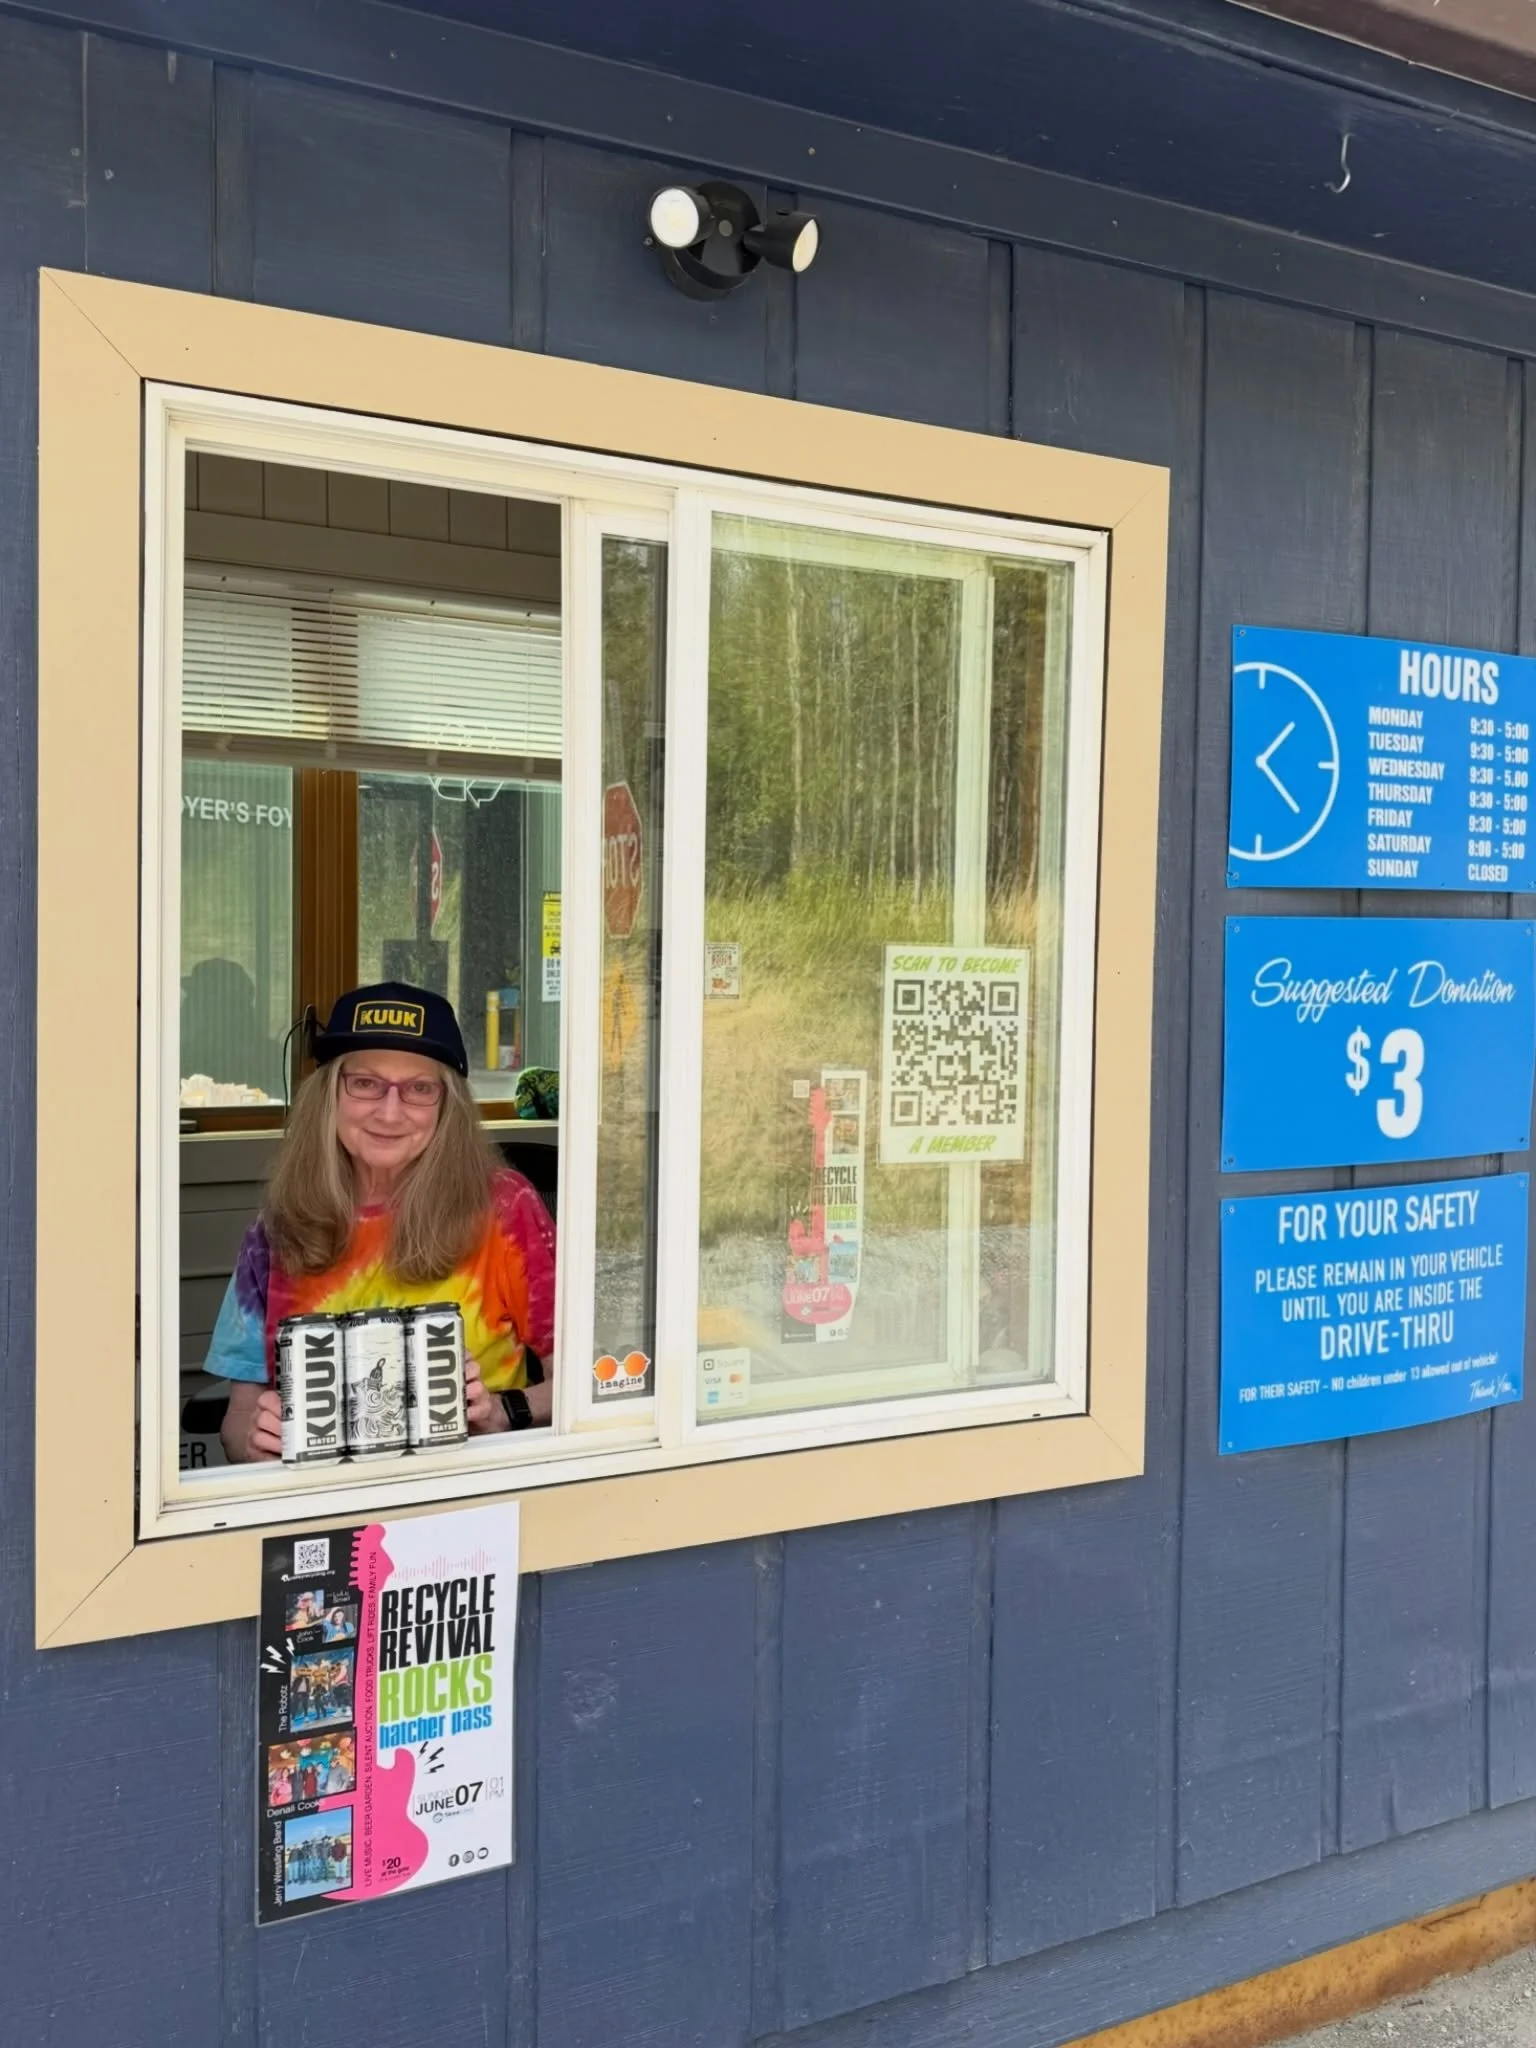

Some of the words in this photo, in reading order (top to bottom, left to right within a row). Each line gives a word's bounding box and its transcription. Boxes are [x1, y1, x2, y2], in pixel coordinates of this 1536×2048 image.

[1399, 649, 1499, 705] HOURS
[1368, 706, 1424, 729] MONDAY
[1504, 721, 1529, 740] 5:00
[1368, 731, 1424, 753] TUESDAY
[1504, 746, 1529, 764] 5:00
[1368, 757, 1445, 781] WEDNESDAY
[181, 795, 250, 823] YER'S
[1367, 782, 1433, 805] THURSDAY
[1504, 793, 1528, 812] 5:00
[1367, 808, 1413, 828] FRIDAY
[1502, 817, 1526, 836] 5:00
[1367, 833, 1432, 854] SATURDAY
[1501, 842, 1525, 860] 5:00
[1367, 858, 1419, 878] SUNDAY
[1468, 863, 1508, 882] CLOSED
[892, 955, 932, 972] SCAN
[937, 957, 958, 972] TO
[962, 958, 1022, 974] BECOME
[1251, 957, 1399, 1023] Suggested
[1408, 960, 1516, 1008] Donation
[360, 1009, 417, 1028] KUUK
[1345, 1025, 1425, 1139] $3
[910, 1135, 924, 1154] A
[926, 1135, 997, 1154] MEMBER
[1279, 1203, 1328, 1244] FOR
[1335, 1197, 1399, 1239] YOUR
[1405, 1190, 1480, 1233] SAFETY
[1255, 1265, 1317, 1294] PLEASE
[1324, 1259, 1386, 1287] REMAIN
[1390, 1256, 1405, 1280] IN
[1411, 1252, 1448, 1277] YOUR
[1450, 1244, 1503, 1273] VEHICLE
[812, 1287, 830, 1302] 07
[1282, 1295, 1330, 1322] UNTIL
[1336, 1292, 1368, 1316] YOU
[1374, 1288, 1403, 1313] ARE
[1408, 1281, 1455, 1309] INSIDE
[1460, 1276, 1483, 1301] THE
[1320, 1310, 1454, 1361] DRIVE-THRU
[305, 1331, 336, 1437] KUUK
[426, 1321, 458, 1425] KUUK
[600, 1377, 643, 1389] imagine
[1239, 1386, 1257, 1404] FOR
[1259, 1384, 1285, 1400] THEIR
[1287, 1379, 1321, 1396] SAFETY
[1331, 1376, 1344, 1392] NO
[1346, 1373, 1382, 1389] children
[1383, 1369, 1407, 1385] under
[1411, 1366, 1420, 1380] 13
[1421, 1361, 1451, 1378] allowed
[1451, 1361, 1464, 1373] out
[308, 1437, 335, 1446] WATER
[431, 1423, 457, 1432] WATER
[368, 1571, 376, 1598] FAMILY
[381, 1573, 496, 1631] RECYCLE
[367, 1626, 375, 1643] LIFT
[379, 1614, 496, 1672] REVIVAL
[279, 1685, 288, 1714] Robotz
[379, 1653, 493, 1724] ROCKS
[279, 1715, 287, 1732] The
[379, 1715, 446, 1750] hatcher
[451, 1705, 492, 1735] pass
[364, 1744, 372, 1772] SILENT
[416, 1796, 454, 1815] JUNE
[455, 1780, 483, 1806] 07
[489, 1789, 505, 1801] PM
[267, 1804, 296, 1819] Denali
[364, 1813, 372, 1836] BEER
[273, 1821, 282, 1843] Band
[382, 1857, 401, 1869] $20
[365, 1868, 373, 1888] LIVE
[273, 1883, 283, 1906] Jerry
